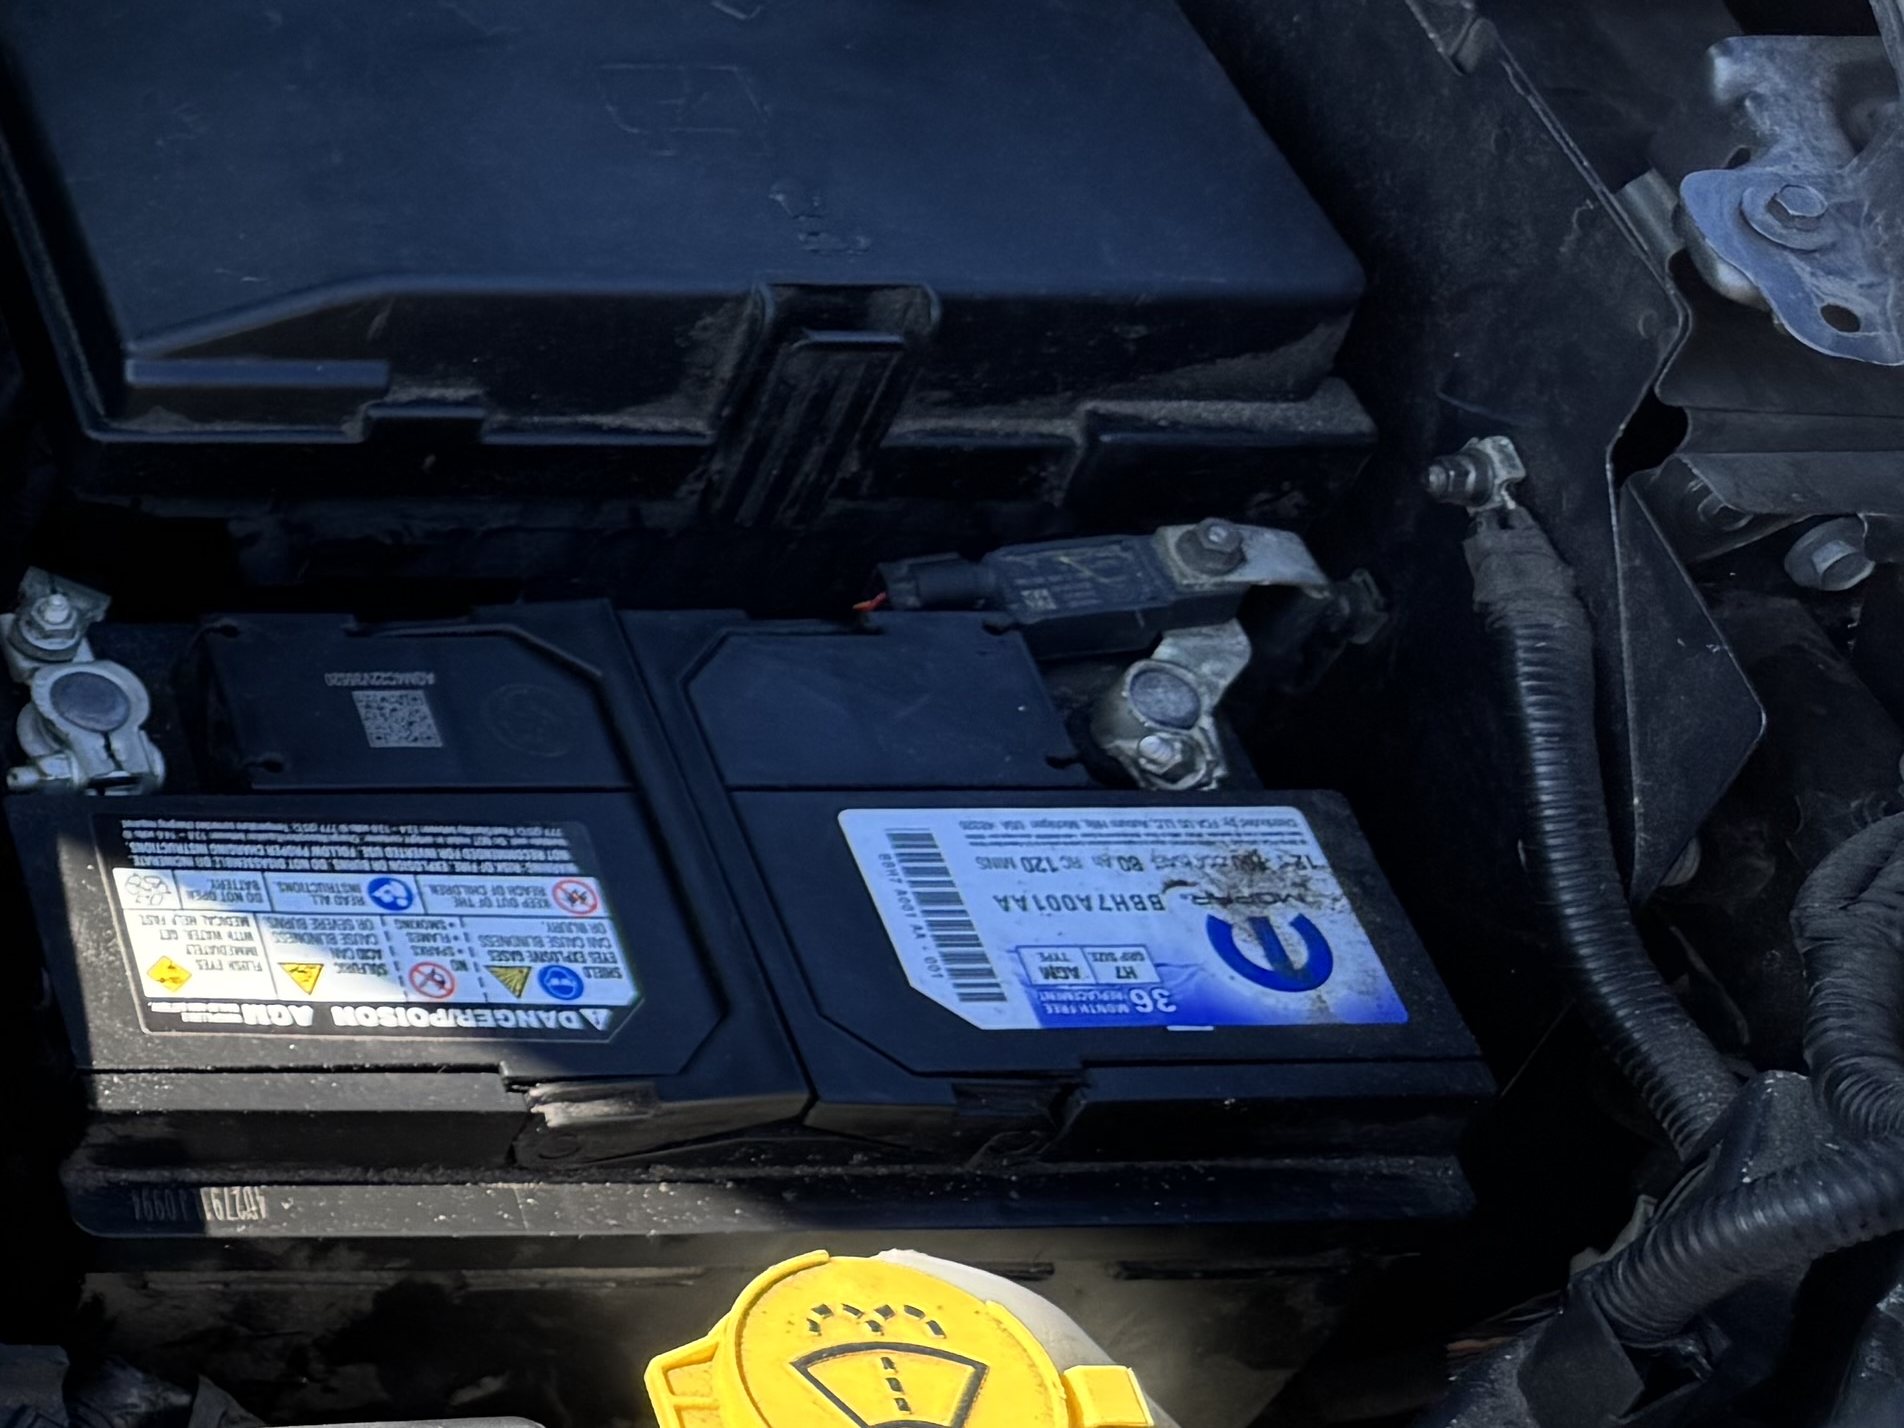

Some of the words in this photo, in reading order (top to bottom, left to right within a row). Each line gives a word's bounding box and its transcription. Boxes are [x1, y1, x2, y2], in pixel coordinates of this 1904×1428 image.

[1020, 856, 1060, 874] 120
[992, 893, 1167, 913] BBH7A001AA
[1037, 965, 1081, 980] AGM
[1115, 965, 1138, 980] H7
[1128, 987, 1178, 1014] 36
[329, 1005, 580, 1030] DANGER/POISON
